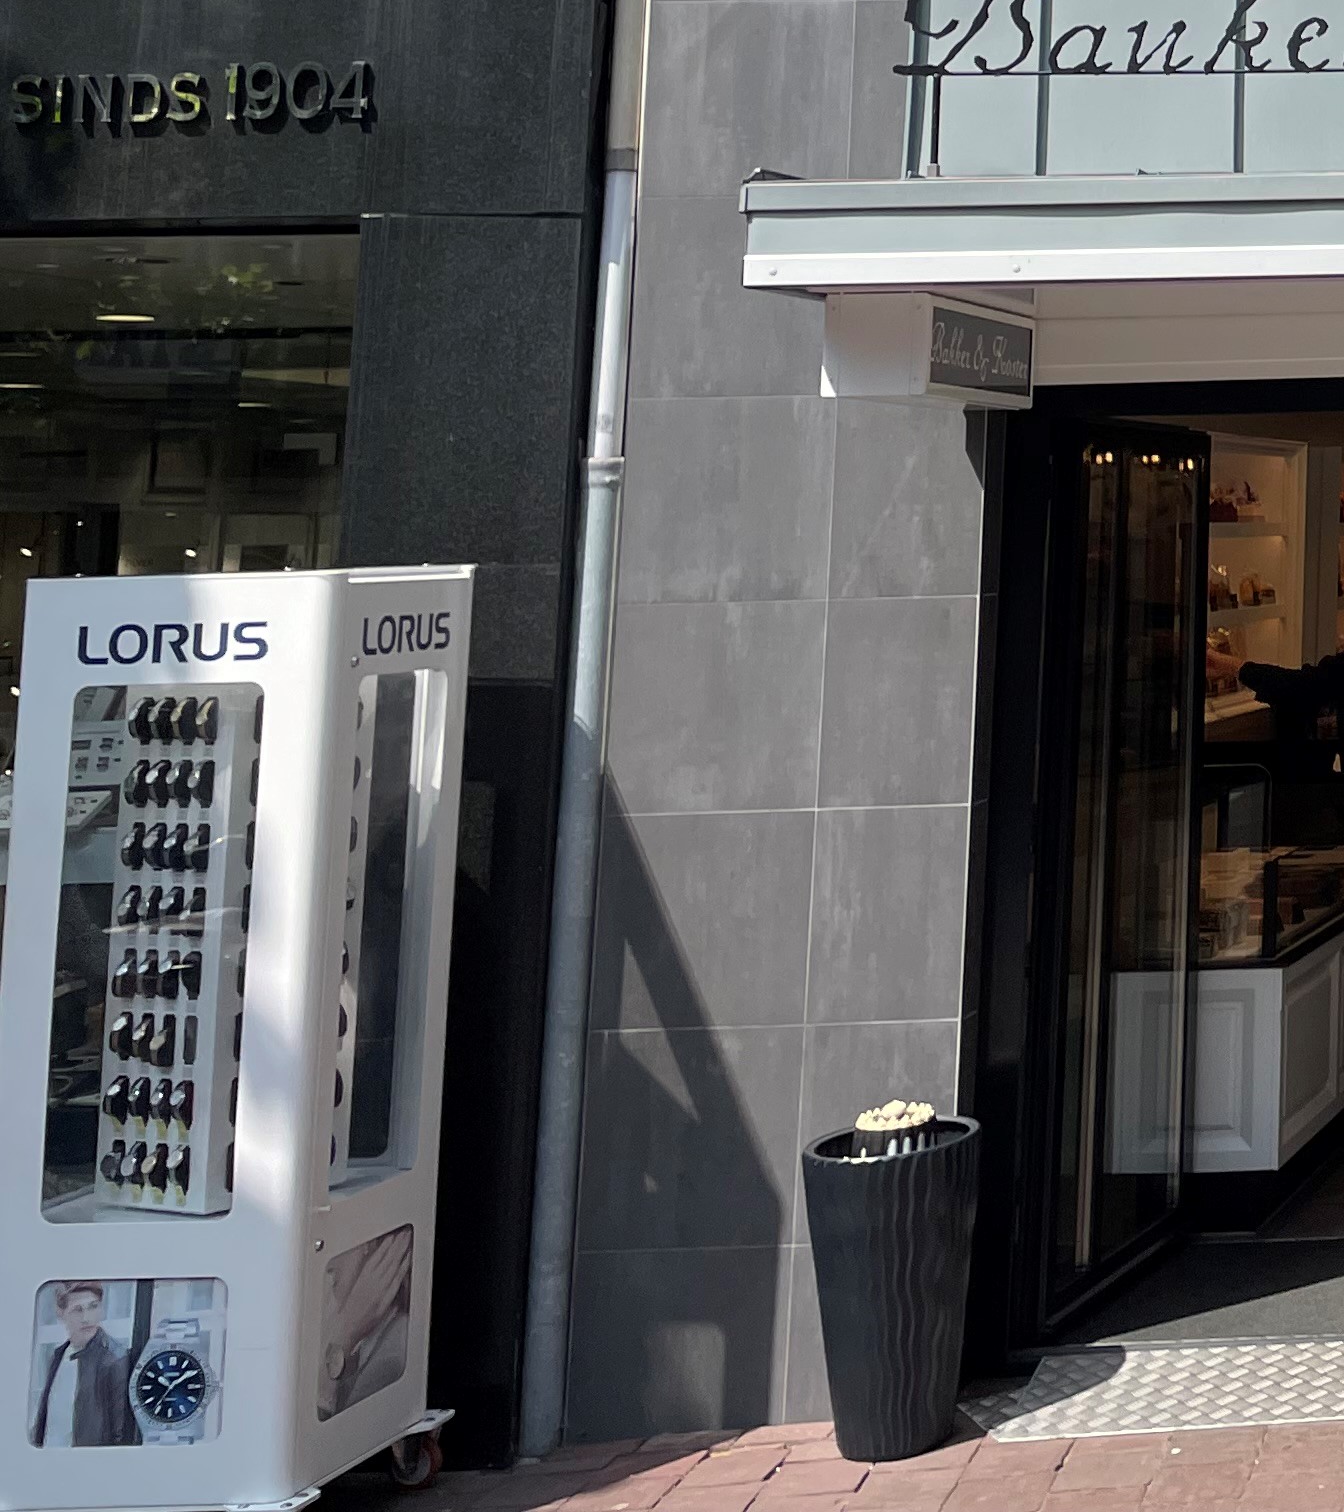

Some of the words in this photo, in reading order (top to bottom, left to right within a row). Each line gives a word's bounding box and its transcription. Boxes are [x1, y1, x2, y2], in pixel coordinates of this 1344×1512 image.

[11, 73, 200, 123] SINDS
[225, 60, 368, 121] 1904
[77, 621, 269, 666] LORUS
[362, 611, 451, 656] LORUS
